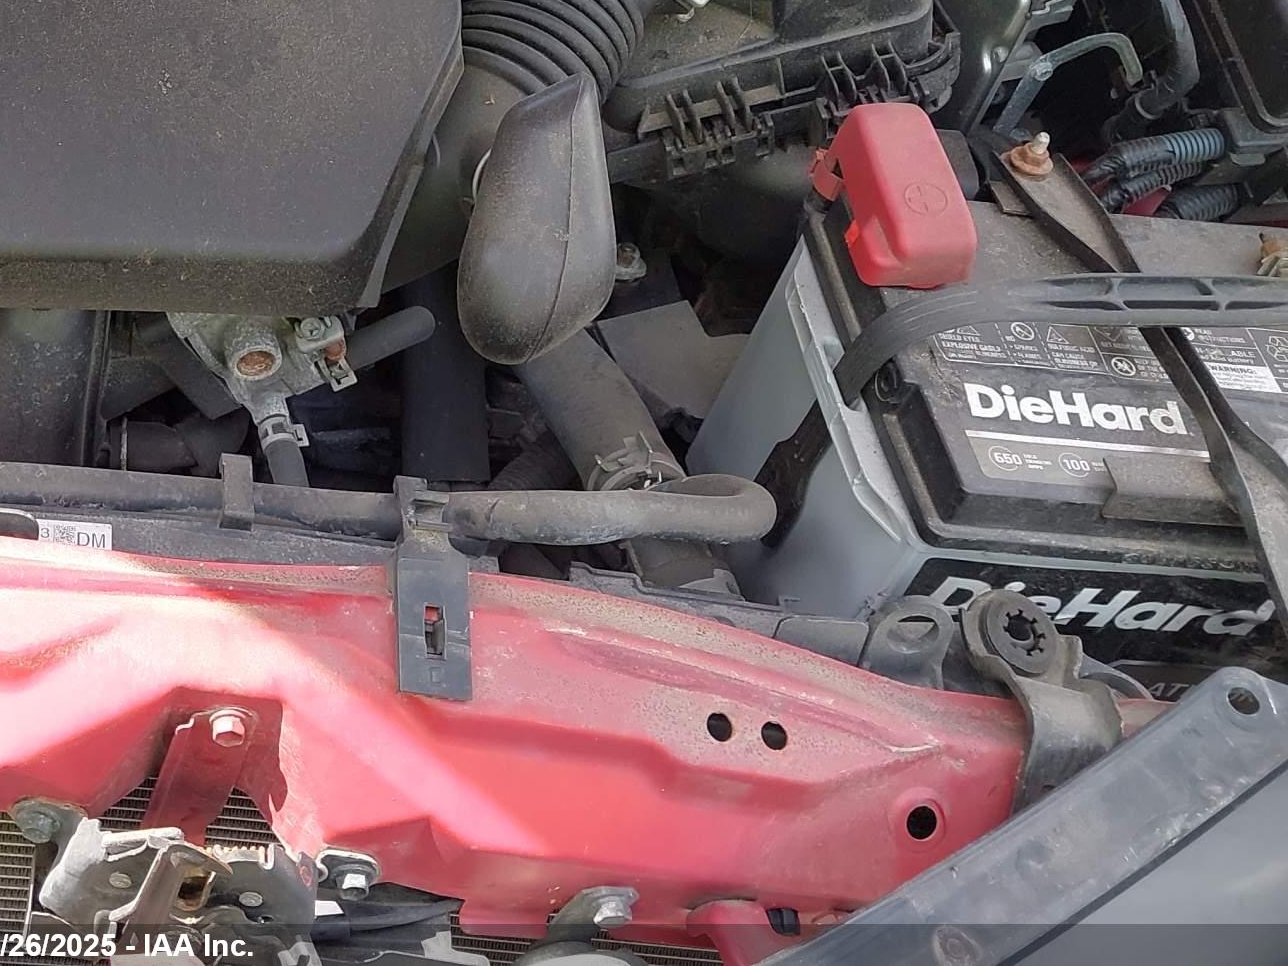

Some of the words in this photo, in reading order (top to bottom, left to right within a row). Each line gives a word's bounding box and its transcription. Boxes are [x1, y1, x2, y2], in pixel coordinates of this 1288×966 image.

[964, 382, 1188, 436] DieHard
[993, 452, 1023, 466] 650
[1063, 459, 1090, 471] 100
[77, 532, 106, 548] DM
